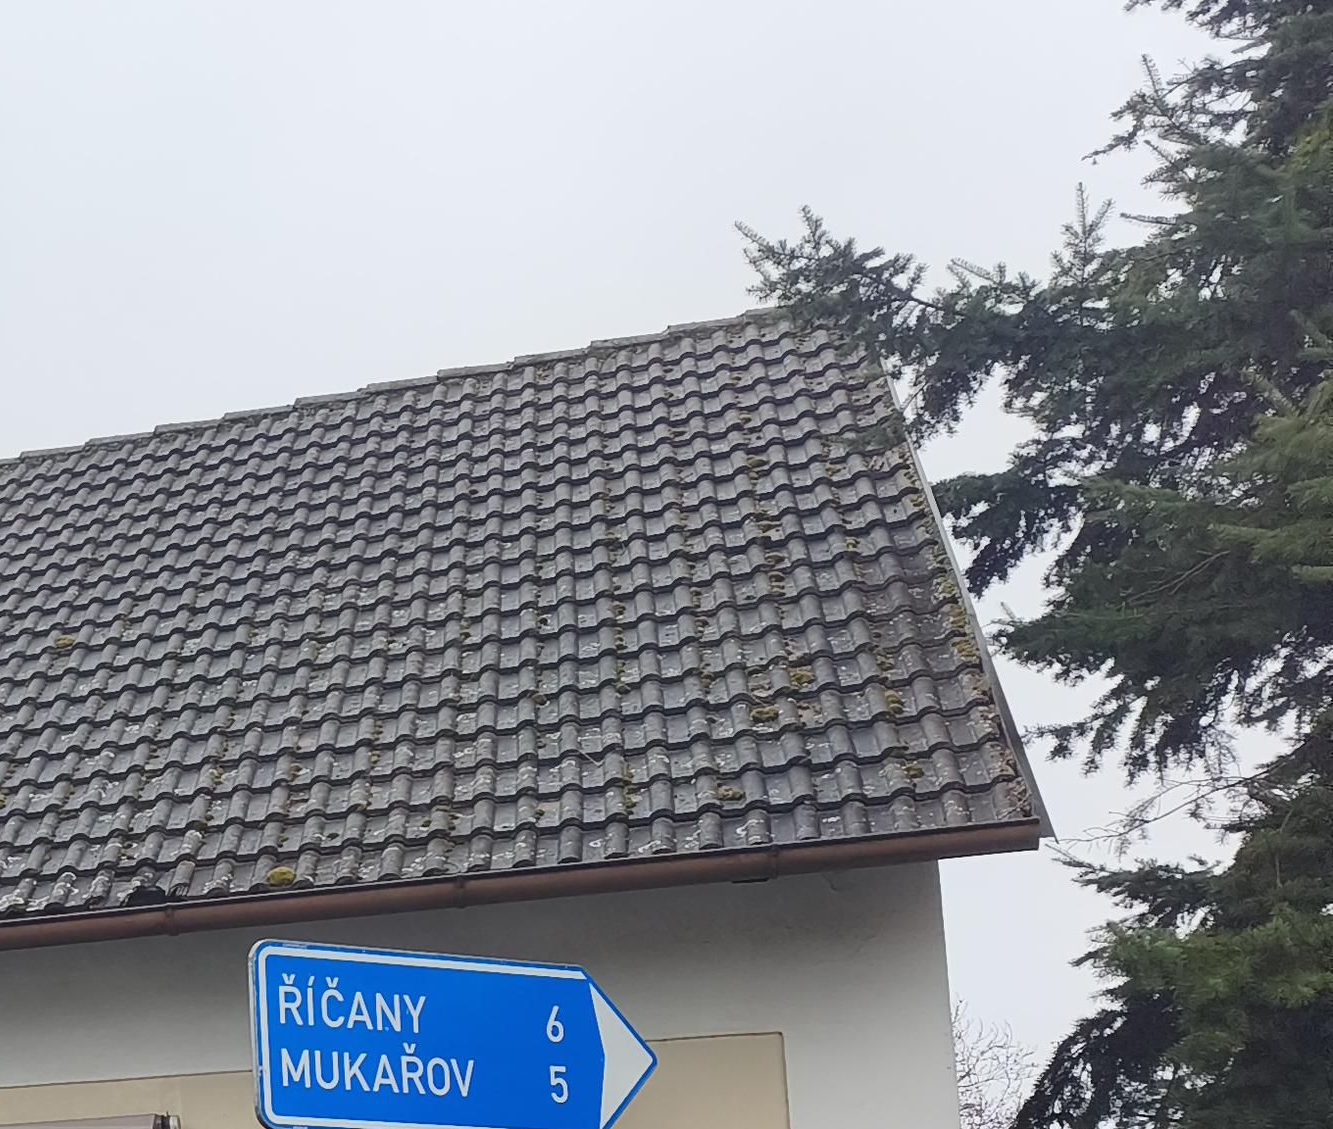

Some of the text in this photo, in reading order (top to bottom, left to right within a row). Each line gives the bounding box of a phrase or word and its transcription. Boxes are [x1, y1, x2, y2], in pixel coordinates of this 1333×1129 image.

[278, 973, 565, 1043] ŘÍČANY 6
[280, 1042, 569, 1104] MUKAŘOV 5
